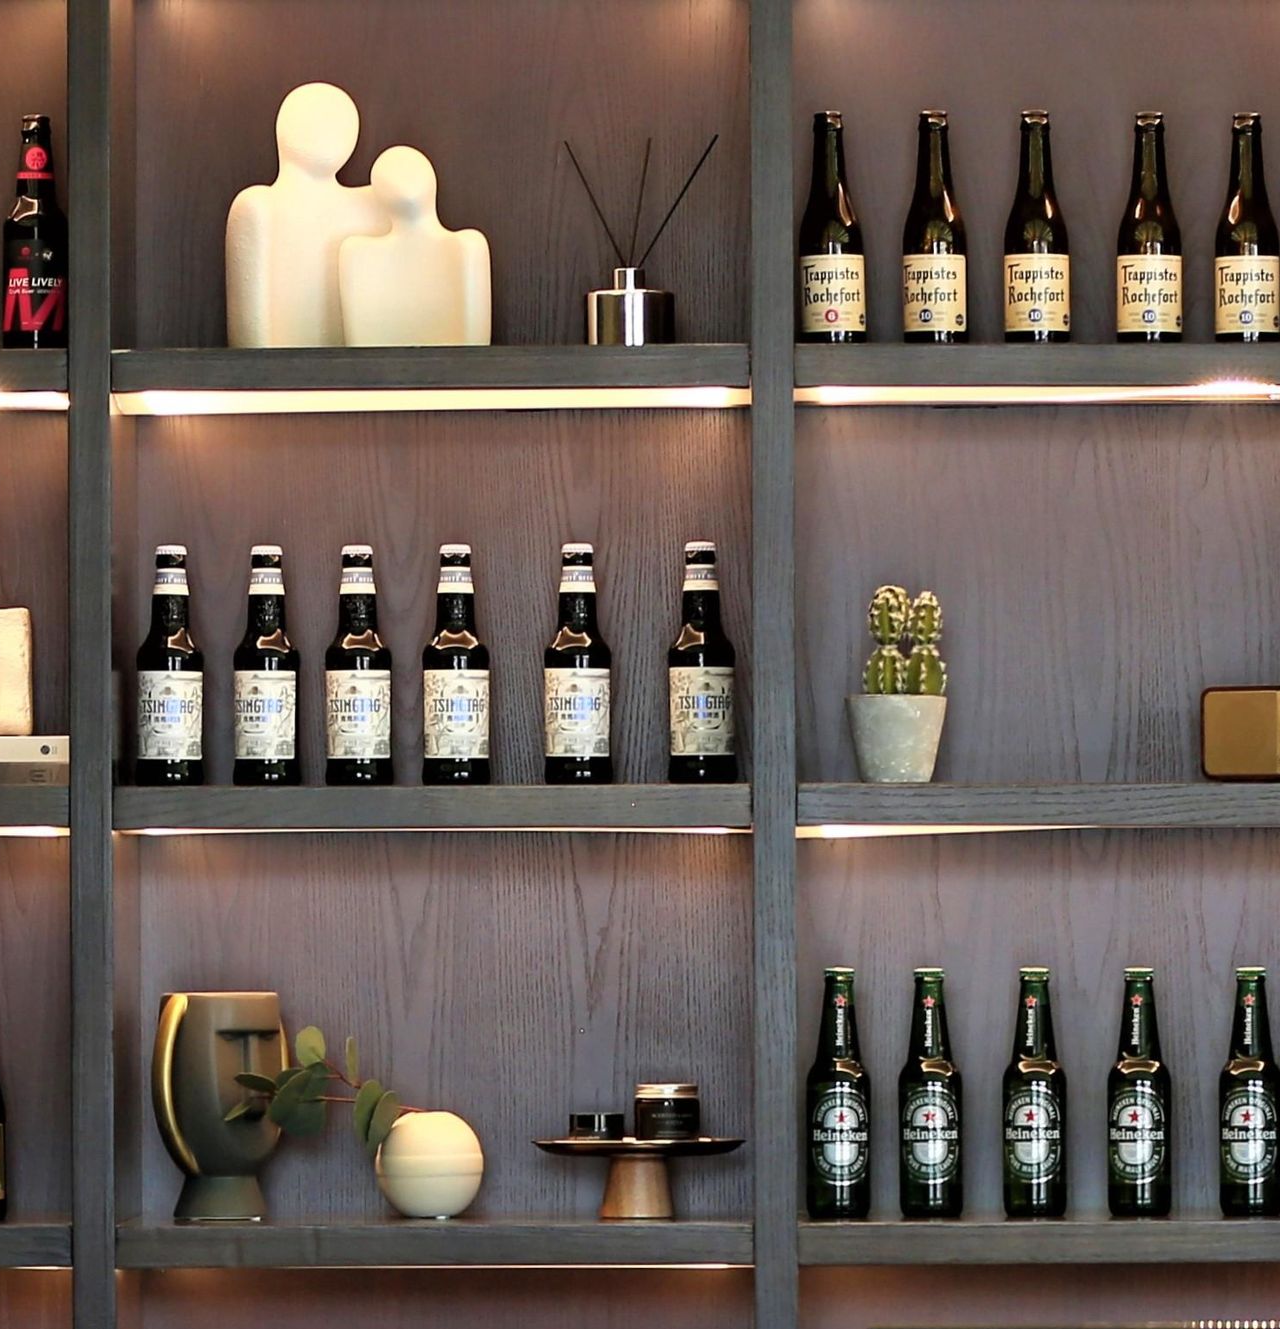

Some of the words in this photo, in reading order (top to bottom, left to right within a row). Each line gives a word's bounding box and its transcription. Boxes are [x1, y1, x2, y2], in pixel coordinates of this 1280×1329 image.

[9, 278, 29, 287] LIVE
[32, 277, 62, 287] LIVELY
[803, 264, 859, 285] Trappistes
[904, 264, 957, 284] Trappistes
[1008, 263, 1064, 284] Trappistes
[1121, 264, 1177, 284] Trappistes
[1218, 265, 1274, 286] Trappistes
[804, 287, 860, 307] Rochefort
[1008, 286, 1064, 306] Rochefort
[1122, 287, 1178, 306] Rochefort
[1219, 288, 1275, 308] Rochefort
[921, 311, 931, 320] 10
[1030, 311, 1040, 320] 10
[1144, 312, 1154, 320] 10
[1241, 312, 1250, 321] 10
[835, 1008, 844, 1046] Heineken
[924, 1008, 932, 1047] Heineken
[1025, 1008, 1033, 1046] Heineken
[1131, 1007, 1140, 1045] Heineken
[1243, 1007, 1252, 1045] Heineken
[813, 1129, 868, 1141] Heineken
[903, 1128, 958, 1140] Heineken
[1005, 1128, 1060, 1139] Heineken
[1110, 1128, 1164, 1140] Heineken
[1222, 1128, 1276, 1140] Heineken
